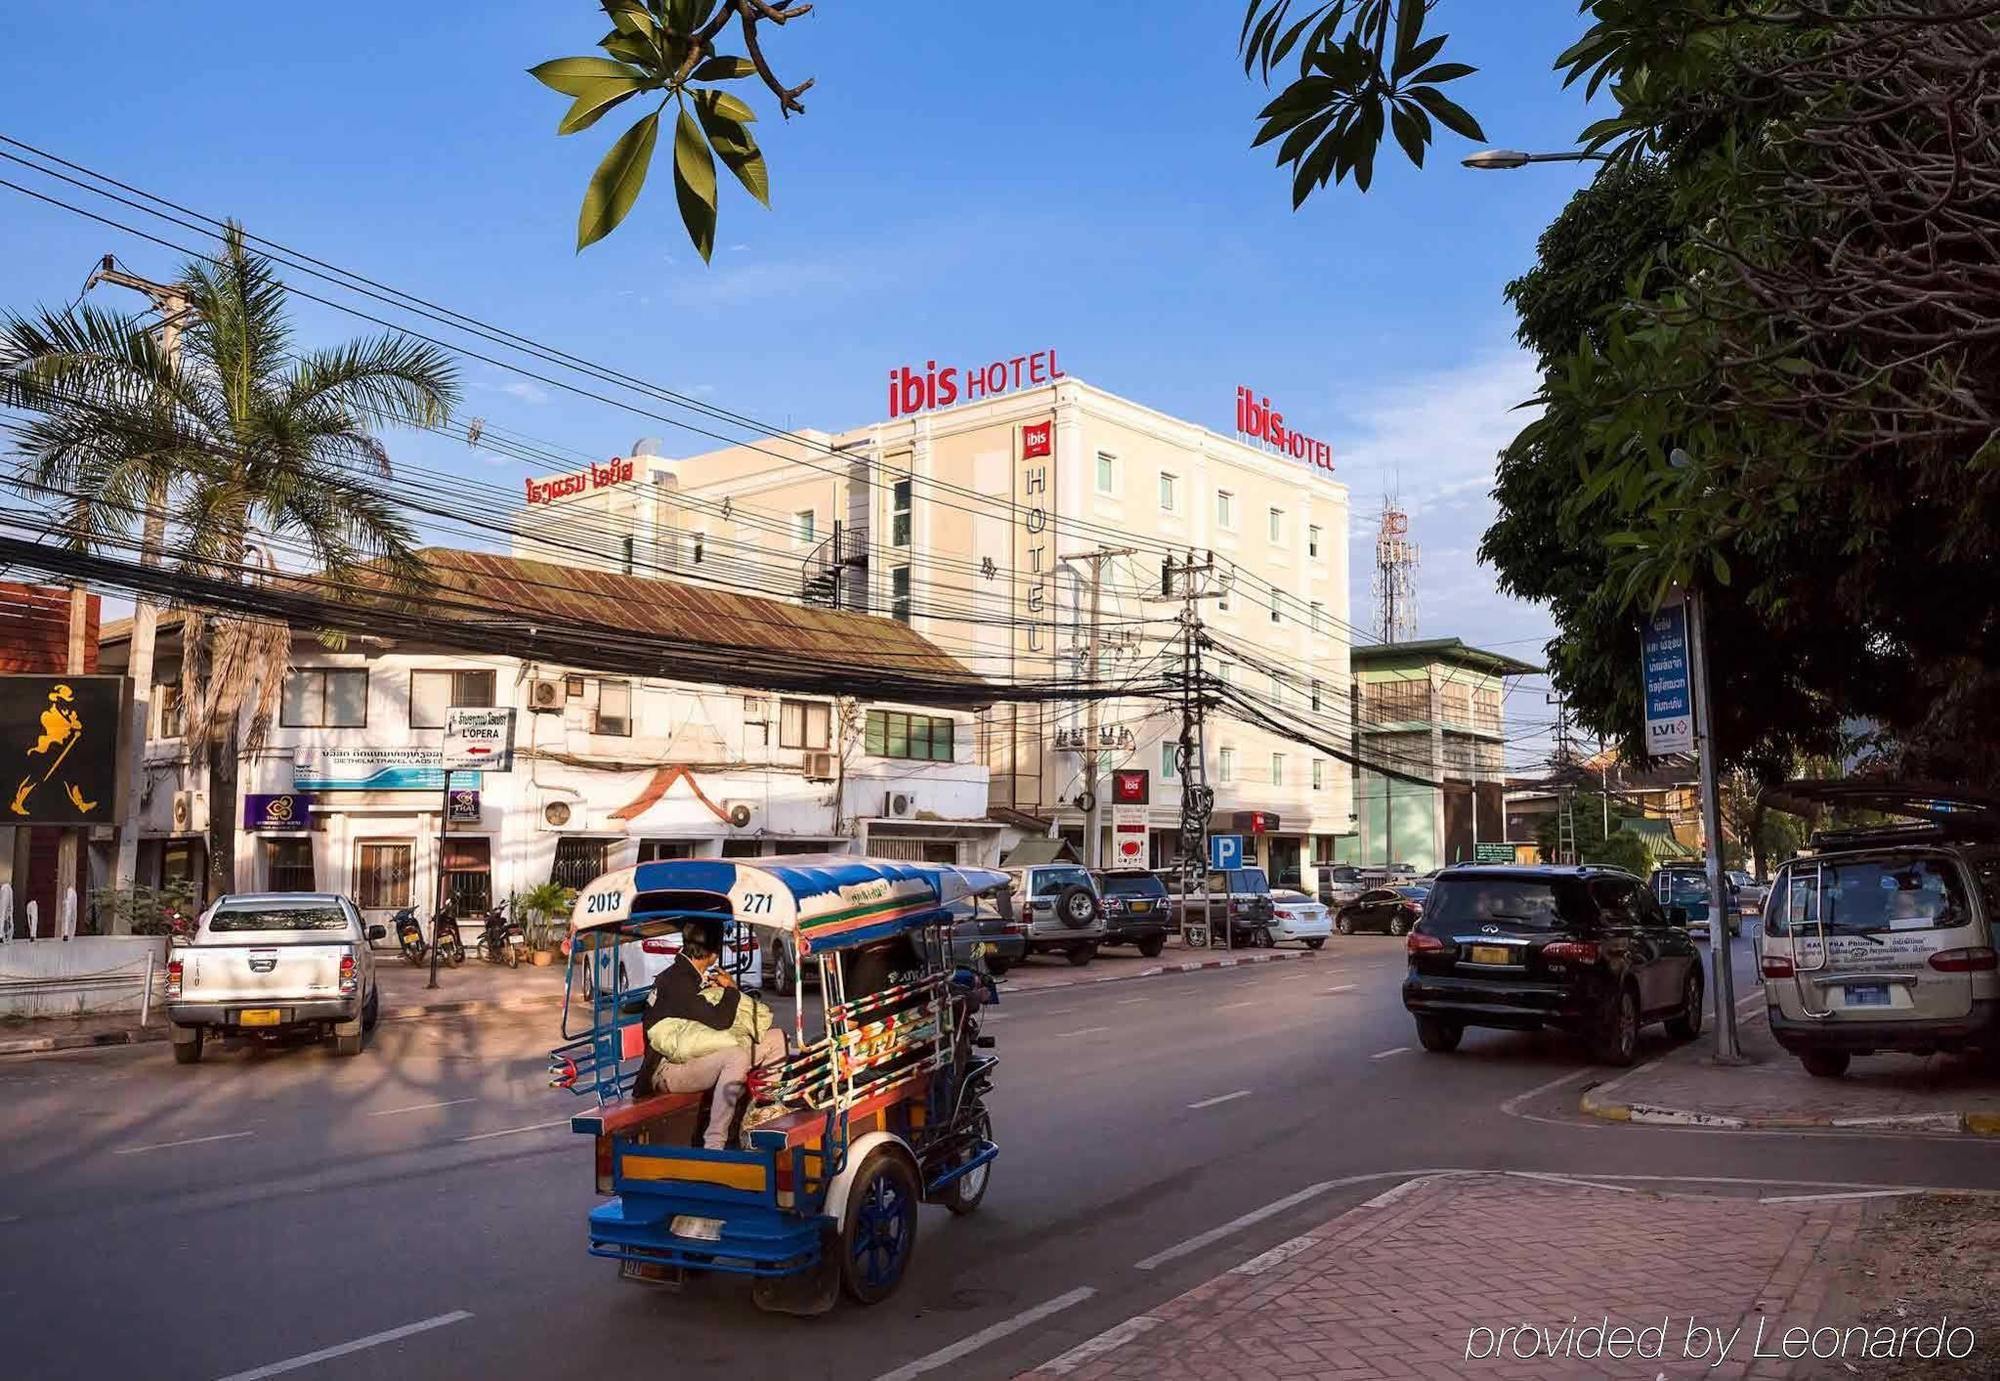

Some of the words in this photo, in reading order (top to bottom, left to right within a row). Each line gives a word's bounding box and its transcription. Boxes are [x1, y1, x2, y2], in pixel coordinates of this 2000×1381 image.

[889, 360, 958, 417] ibis
[967, 349, 1066, 399] HOTEL
[1026, 430, 1047, 447] ibis
[1237, 385, 1284, 446] ibis
[1280, 427, 1335, 472] HOTEL
[1026, 466, 1046, 652] HOTEL
[462, 728, 499, 738] L'OPERA
[1218, 838, 1235, 868] P
[587, 891, 622, 913] 2013
[743, 893, 773, 914] 271
